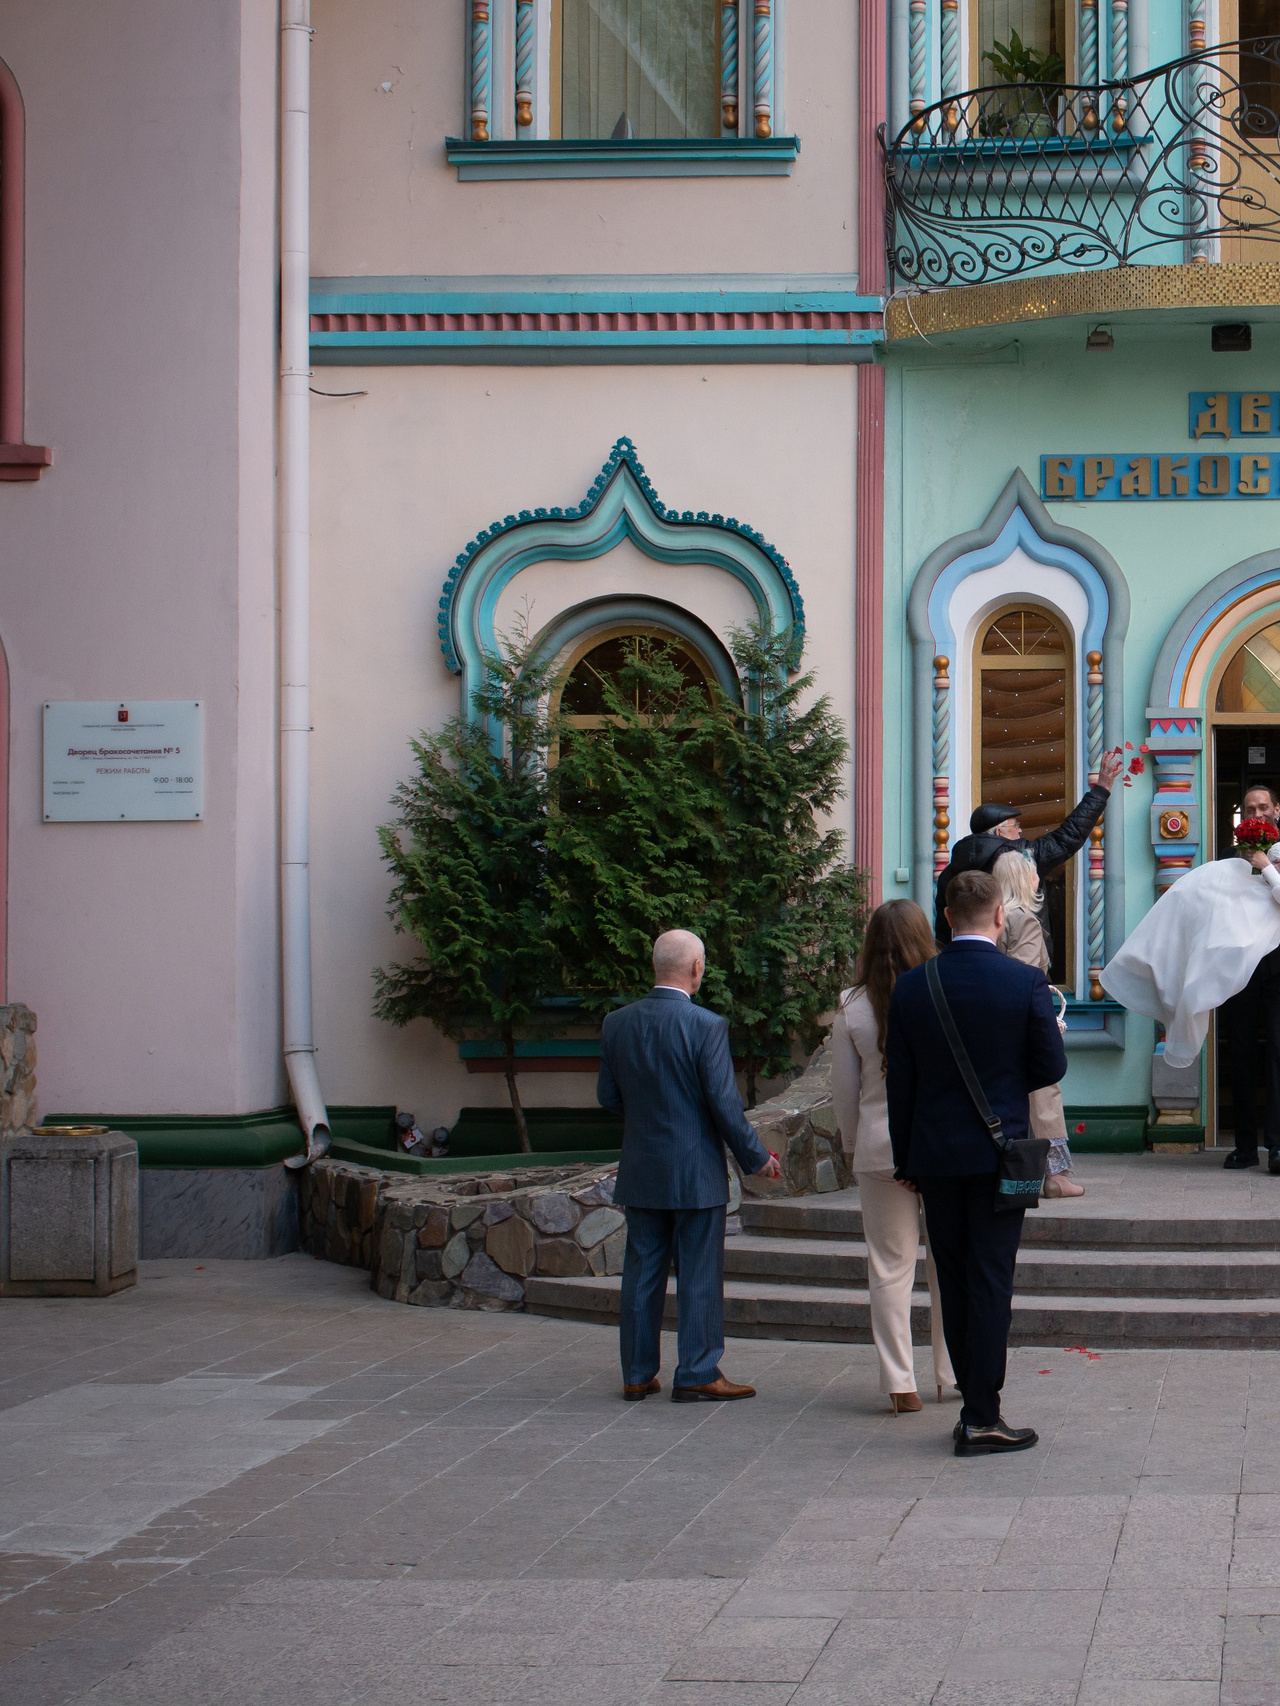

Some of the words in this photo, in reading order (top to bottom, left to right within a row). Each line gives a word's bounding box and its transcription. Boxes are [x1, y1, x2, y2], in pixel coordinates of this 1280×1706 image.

[68, 748, 97, 756] Дворец
[98, 748, 162, 756] бракосочетания
[1016, 1180, 1042, 1191] BOSS
